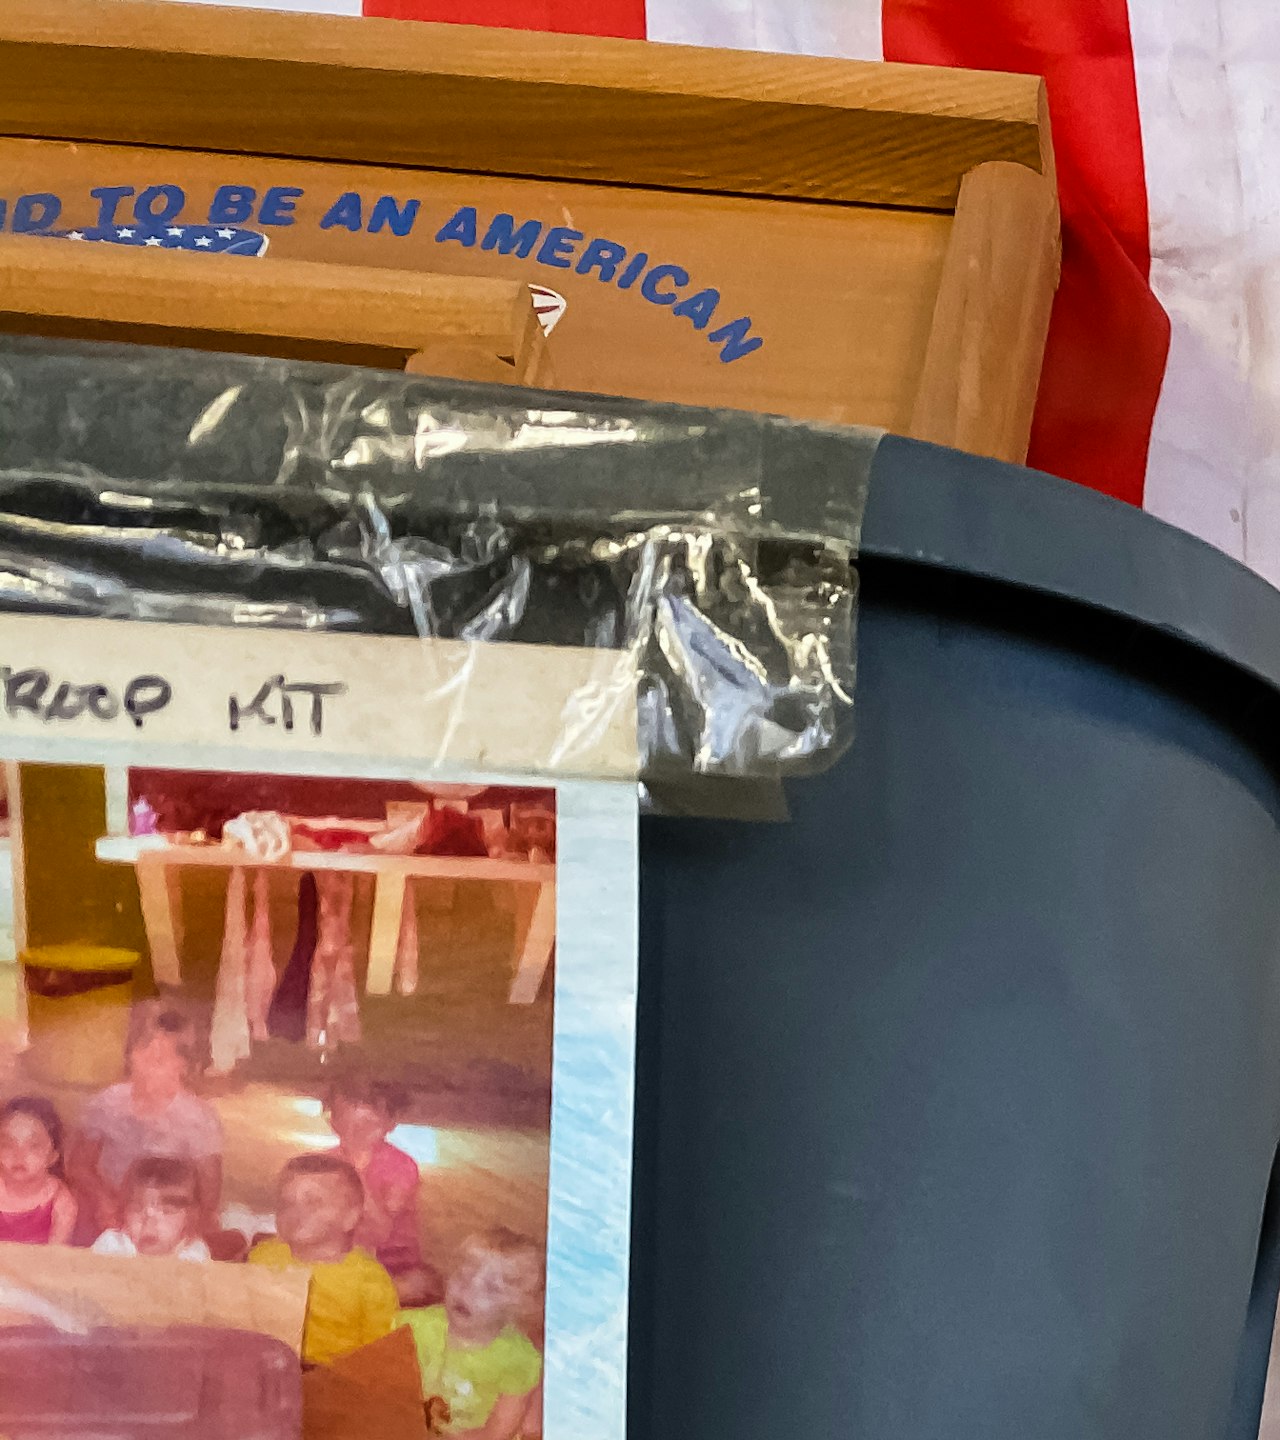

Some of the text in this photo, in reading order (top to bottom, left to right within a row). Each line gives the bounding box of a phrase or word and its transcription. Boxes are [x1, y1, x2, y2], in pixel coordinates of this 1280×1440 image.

[90, 184, 185, 228] TO
[208, 185, 304, 227] BE
[320, 194, 421, 236] AN
[434, 205, 763, 364] AMERICAN
[228, 674, 345, 735] KIT
